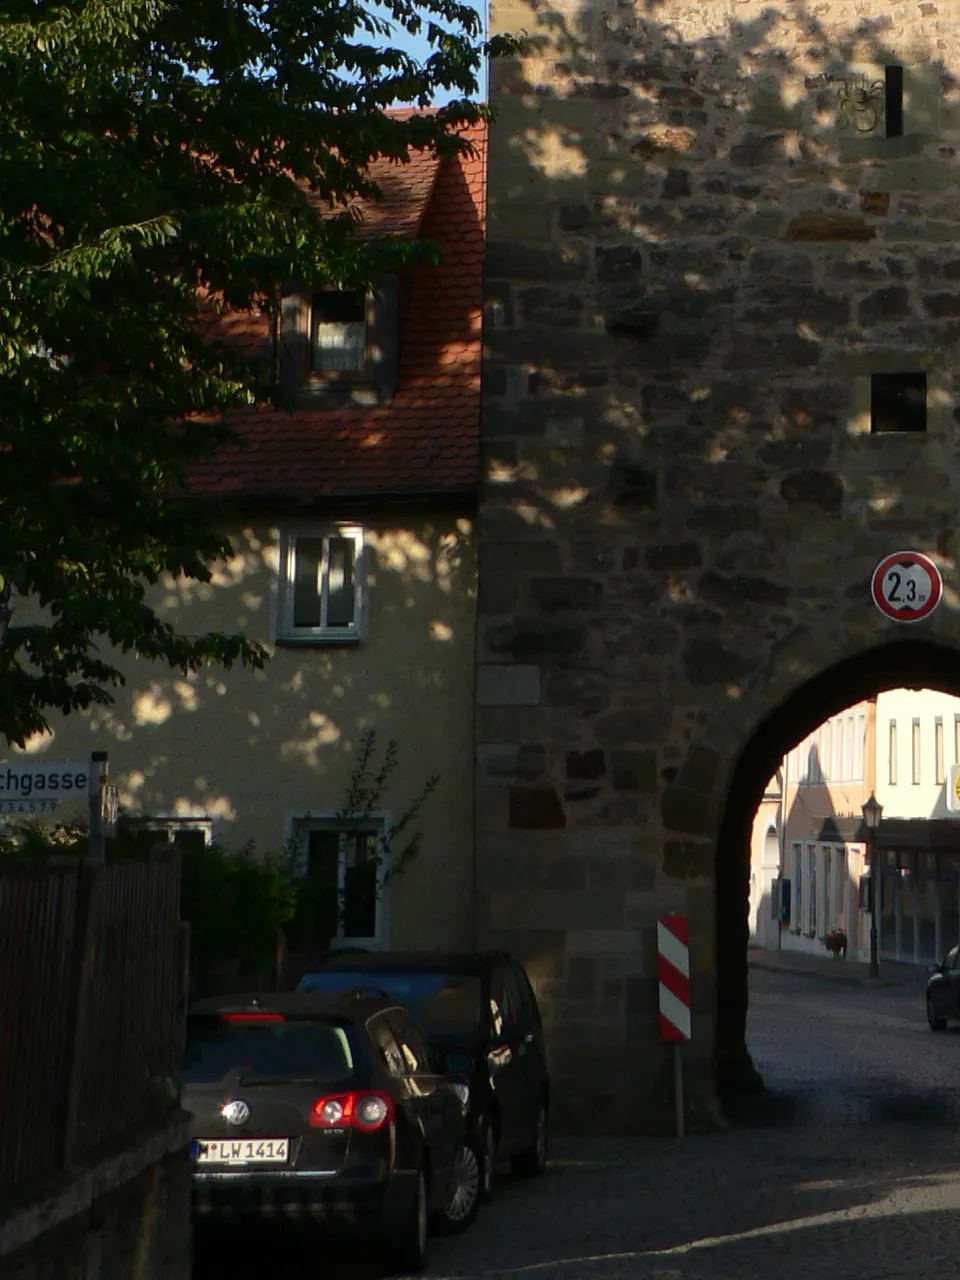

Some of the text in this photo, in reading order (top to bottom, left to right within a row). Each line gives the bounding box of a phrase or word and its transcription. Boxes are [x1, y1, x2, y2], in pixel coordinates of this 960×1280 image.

[888, 572, 916, 603] 2,3
[197, 1142, 286, 1160] M LW 1414
